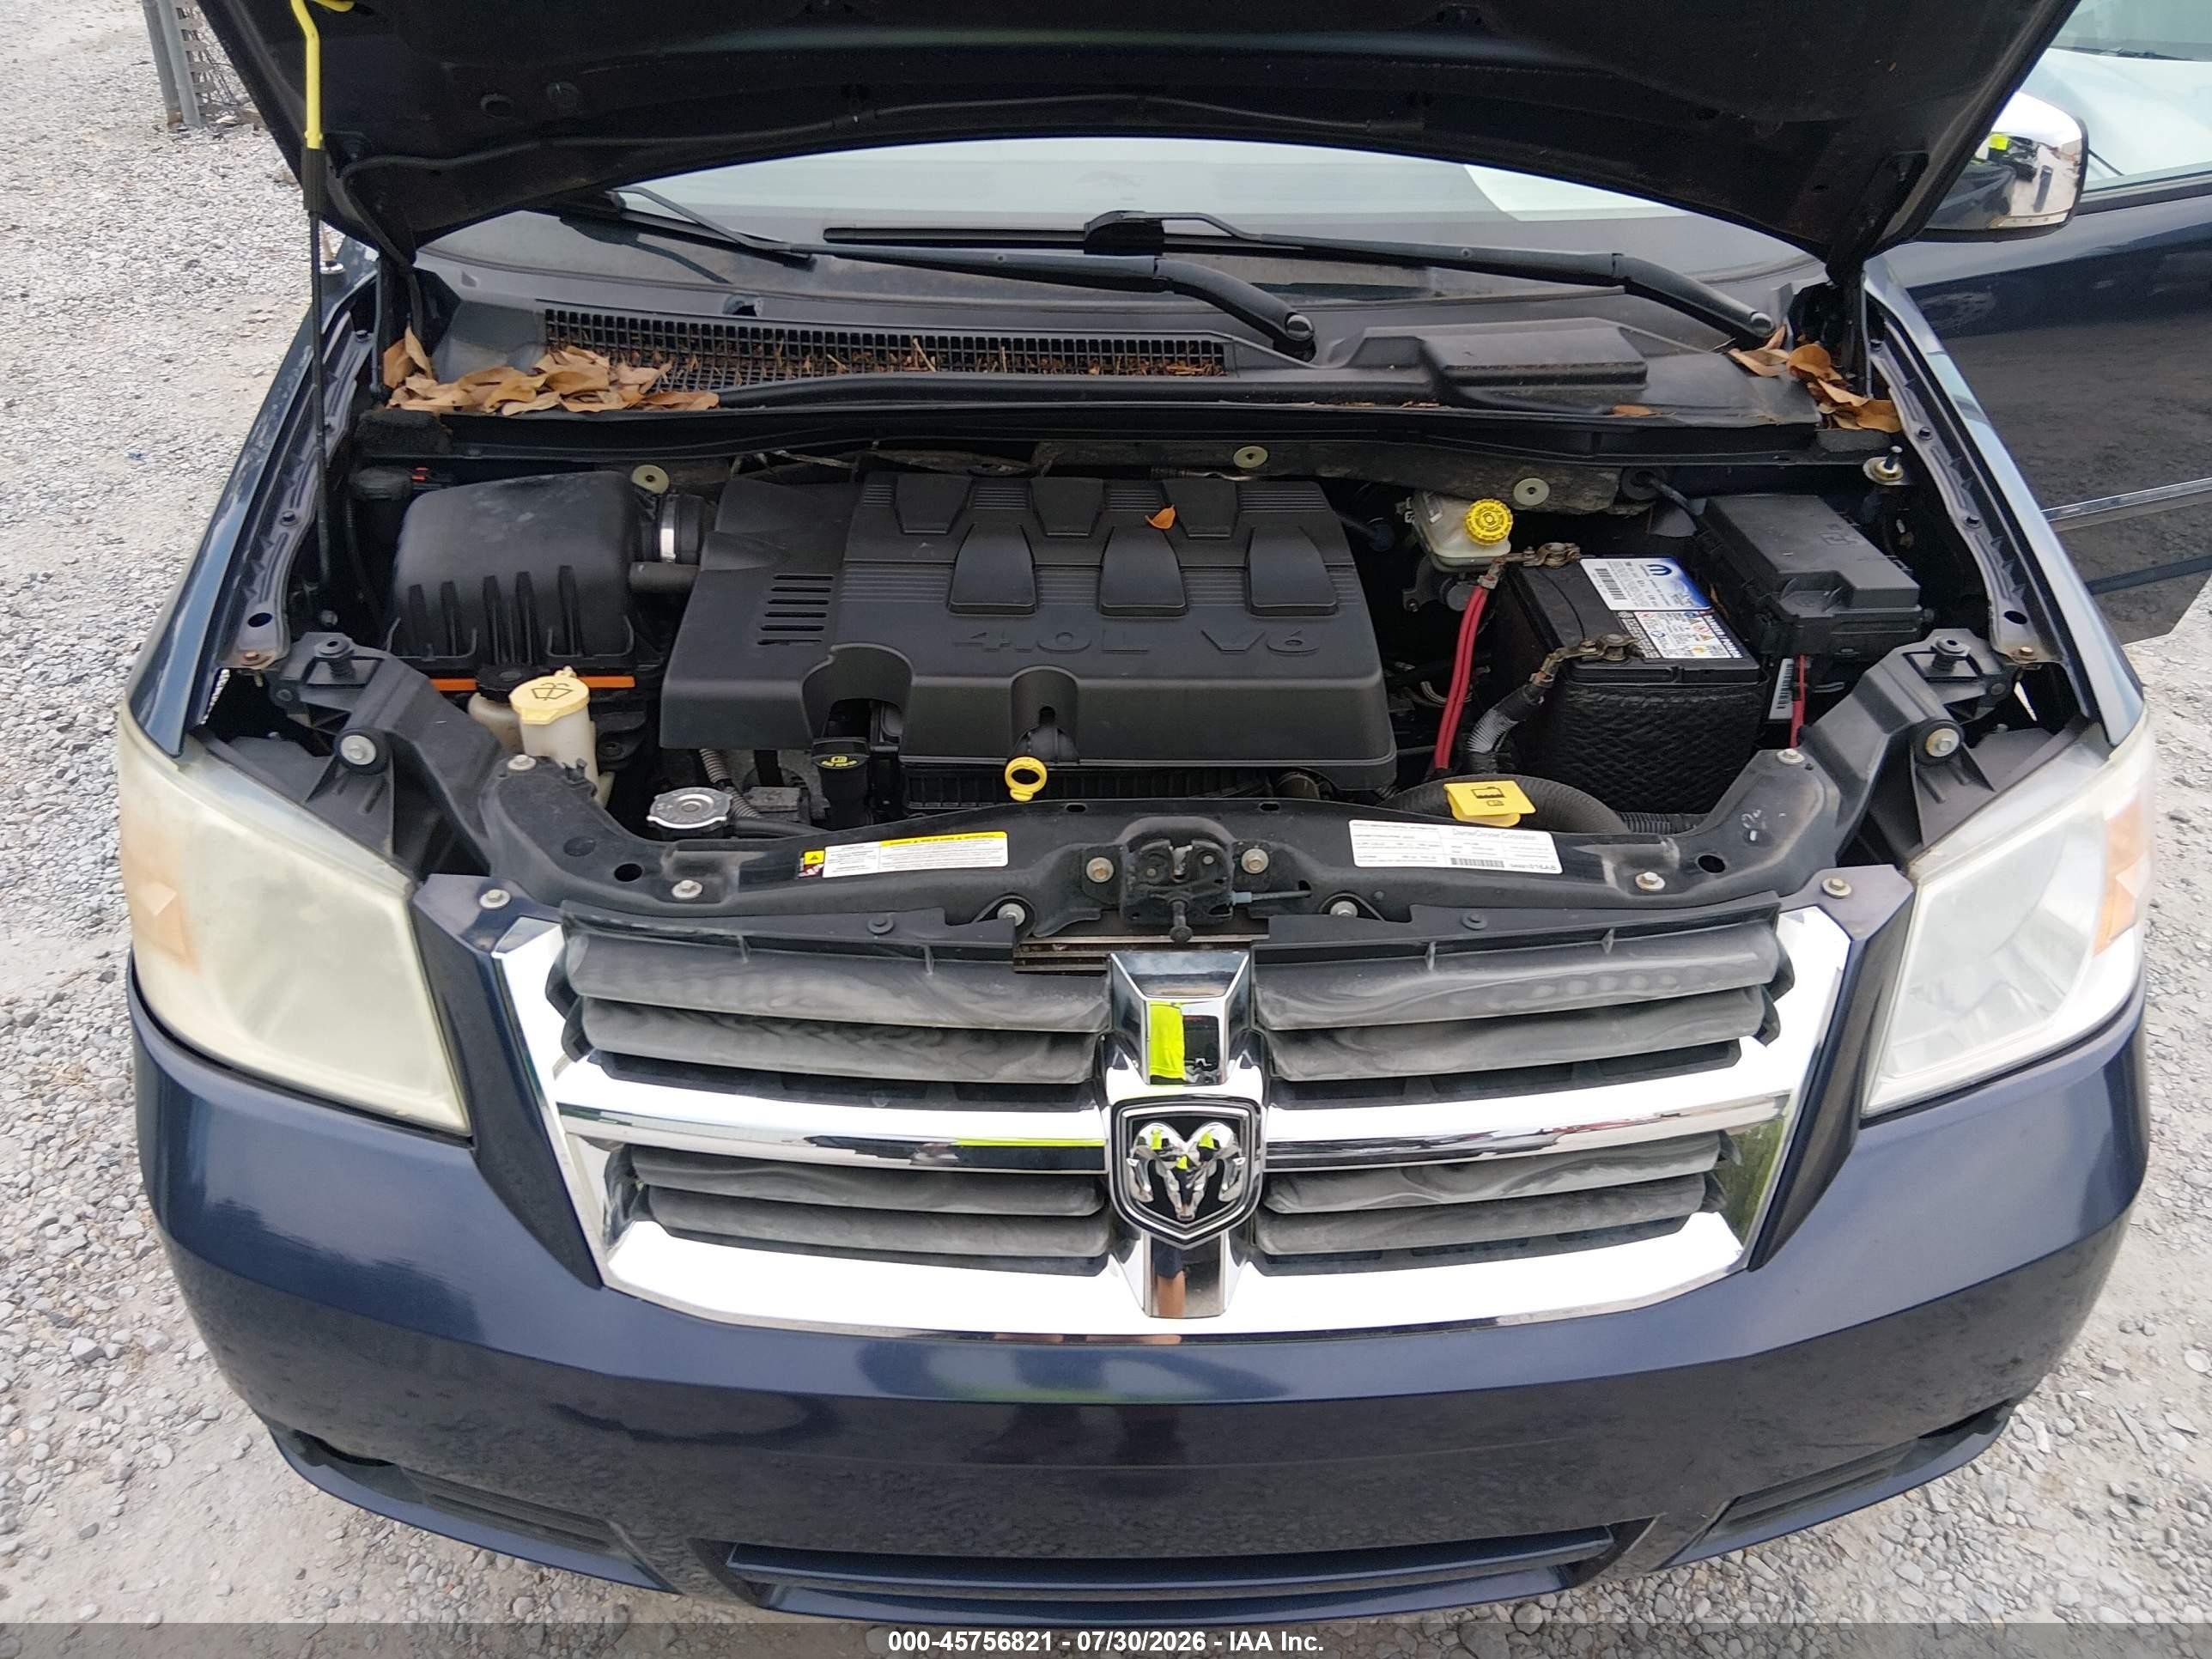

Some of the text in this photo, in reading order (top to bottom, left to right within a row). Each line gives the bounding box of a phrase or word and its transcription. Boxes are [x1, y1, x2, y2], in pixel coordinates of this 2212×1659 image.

[951, 629, 1321, 656] 4.0L V6
[1703, 615, 1726, 635] DANGER
[1719, 638, 1743, 659] POISON
